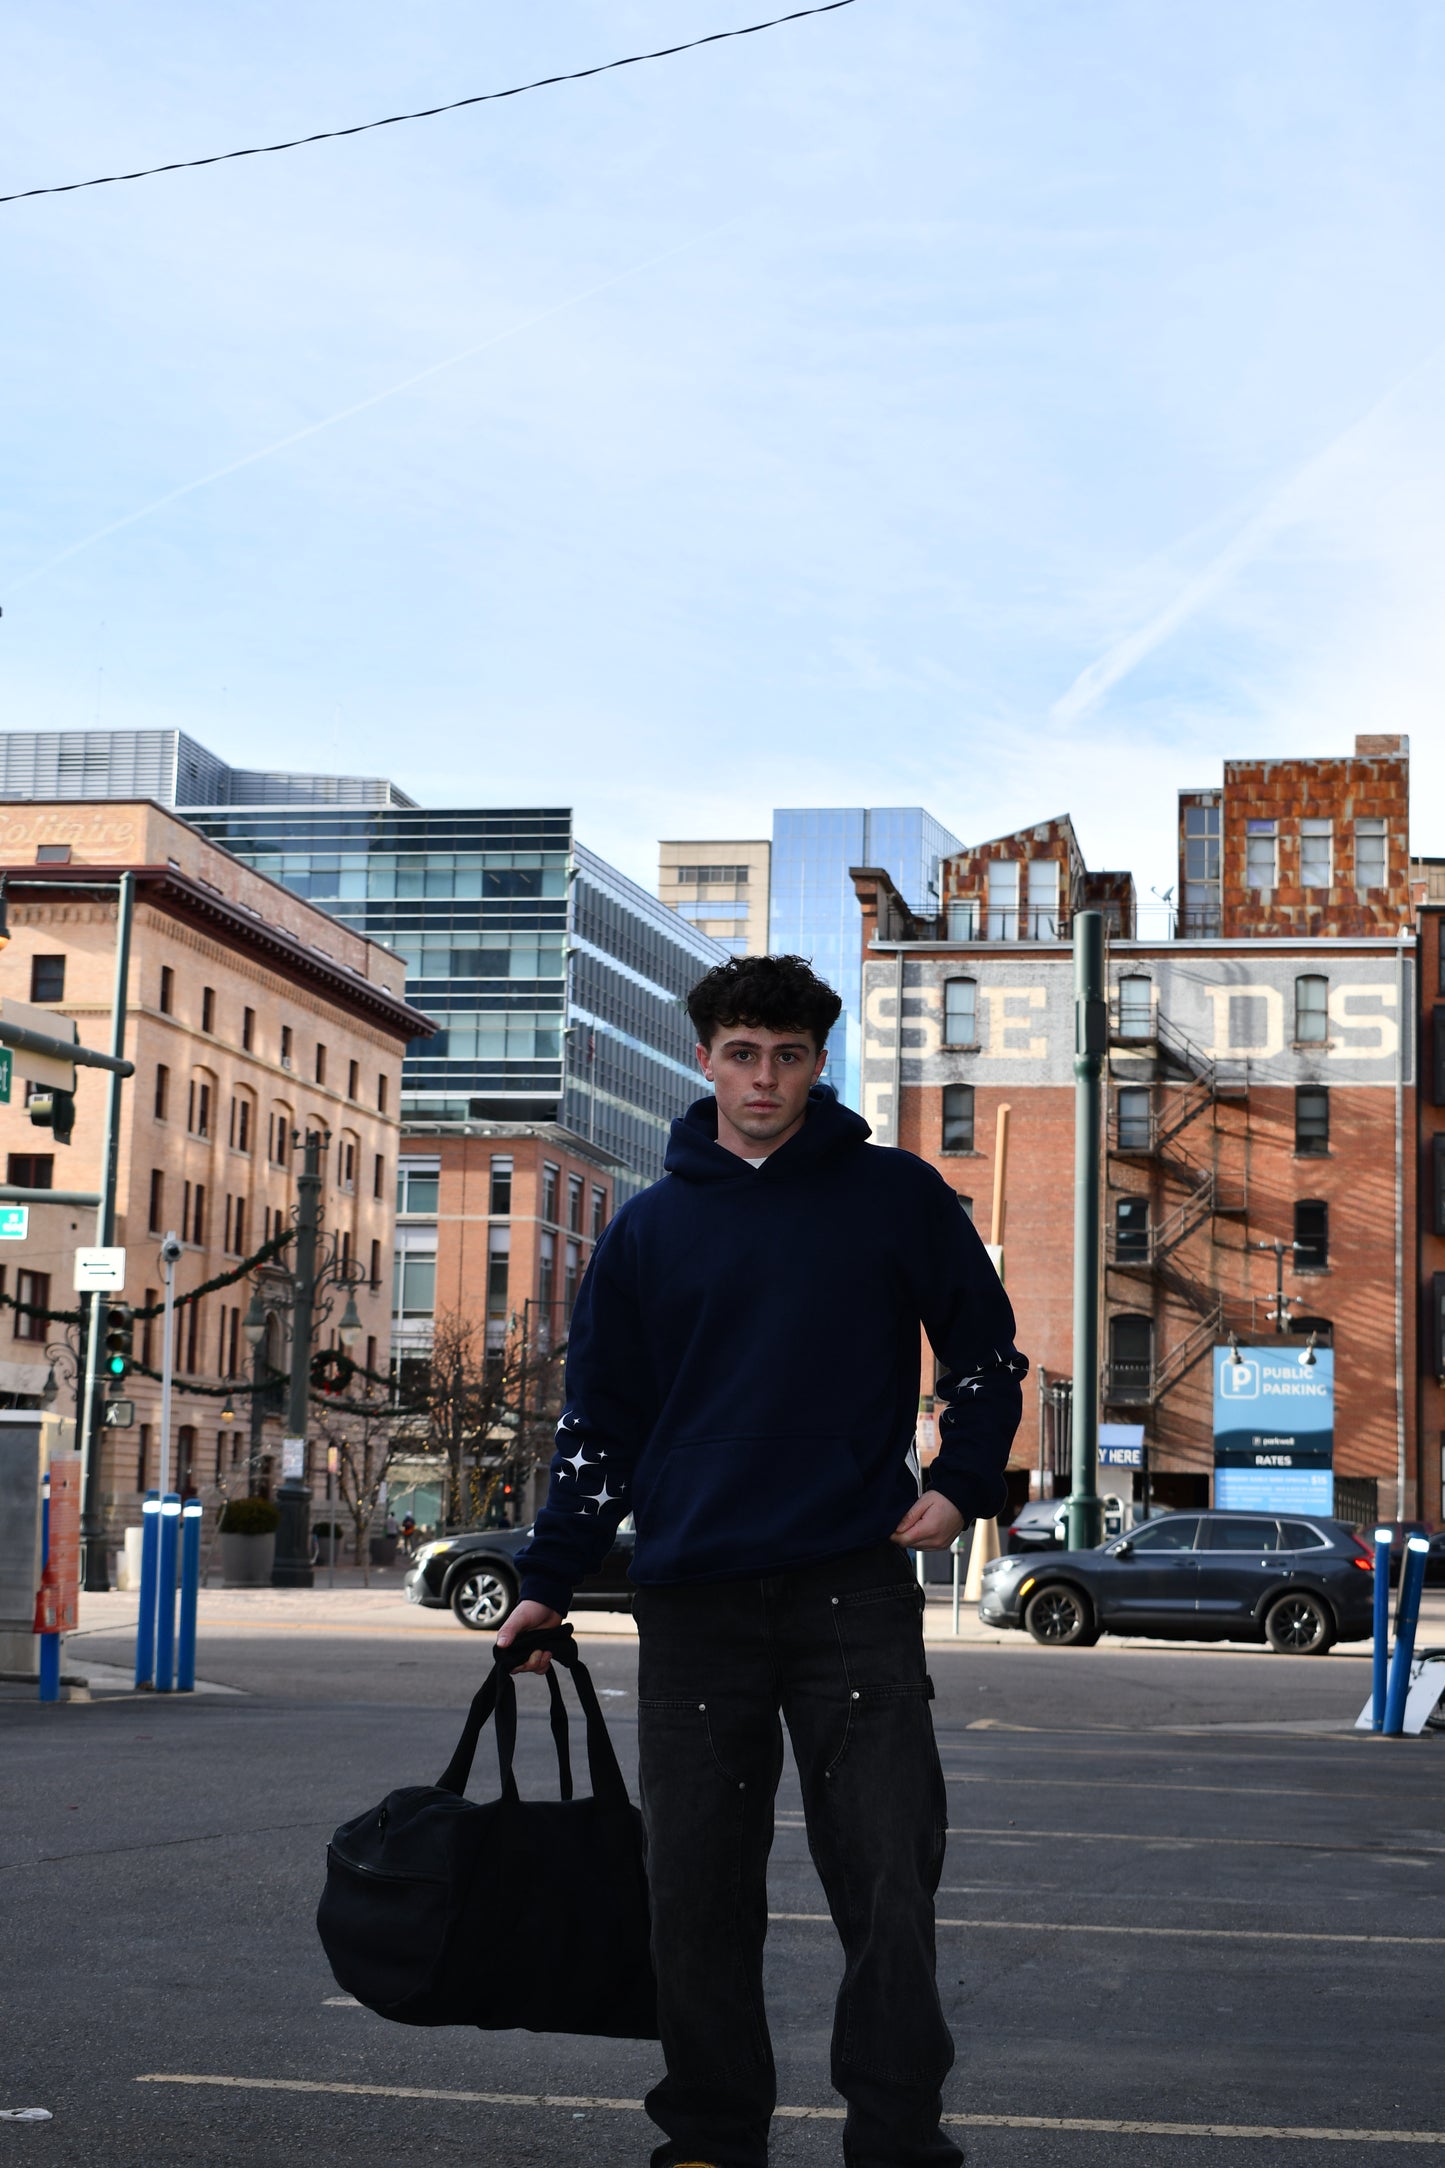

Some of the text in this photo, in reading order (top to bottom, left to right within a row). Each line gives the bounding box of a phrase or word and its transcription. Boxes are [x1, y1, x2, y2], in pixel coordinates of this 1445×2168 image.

[1263, 1367, 1313, 1380] PUBLIC
[1263, 1384, 1327, 1395] PARKING
[1109, 1449, 1140, 1464] HERE
[1255, 1455, 1292, 1466] RATES
